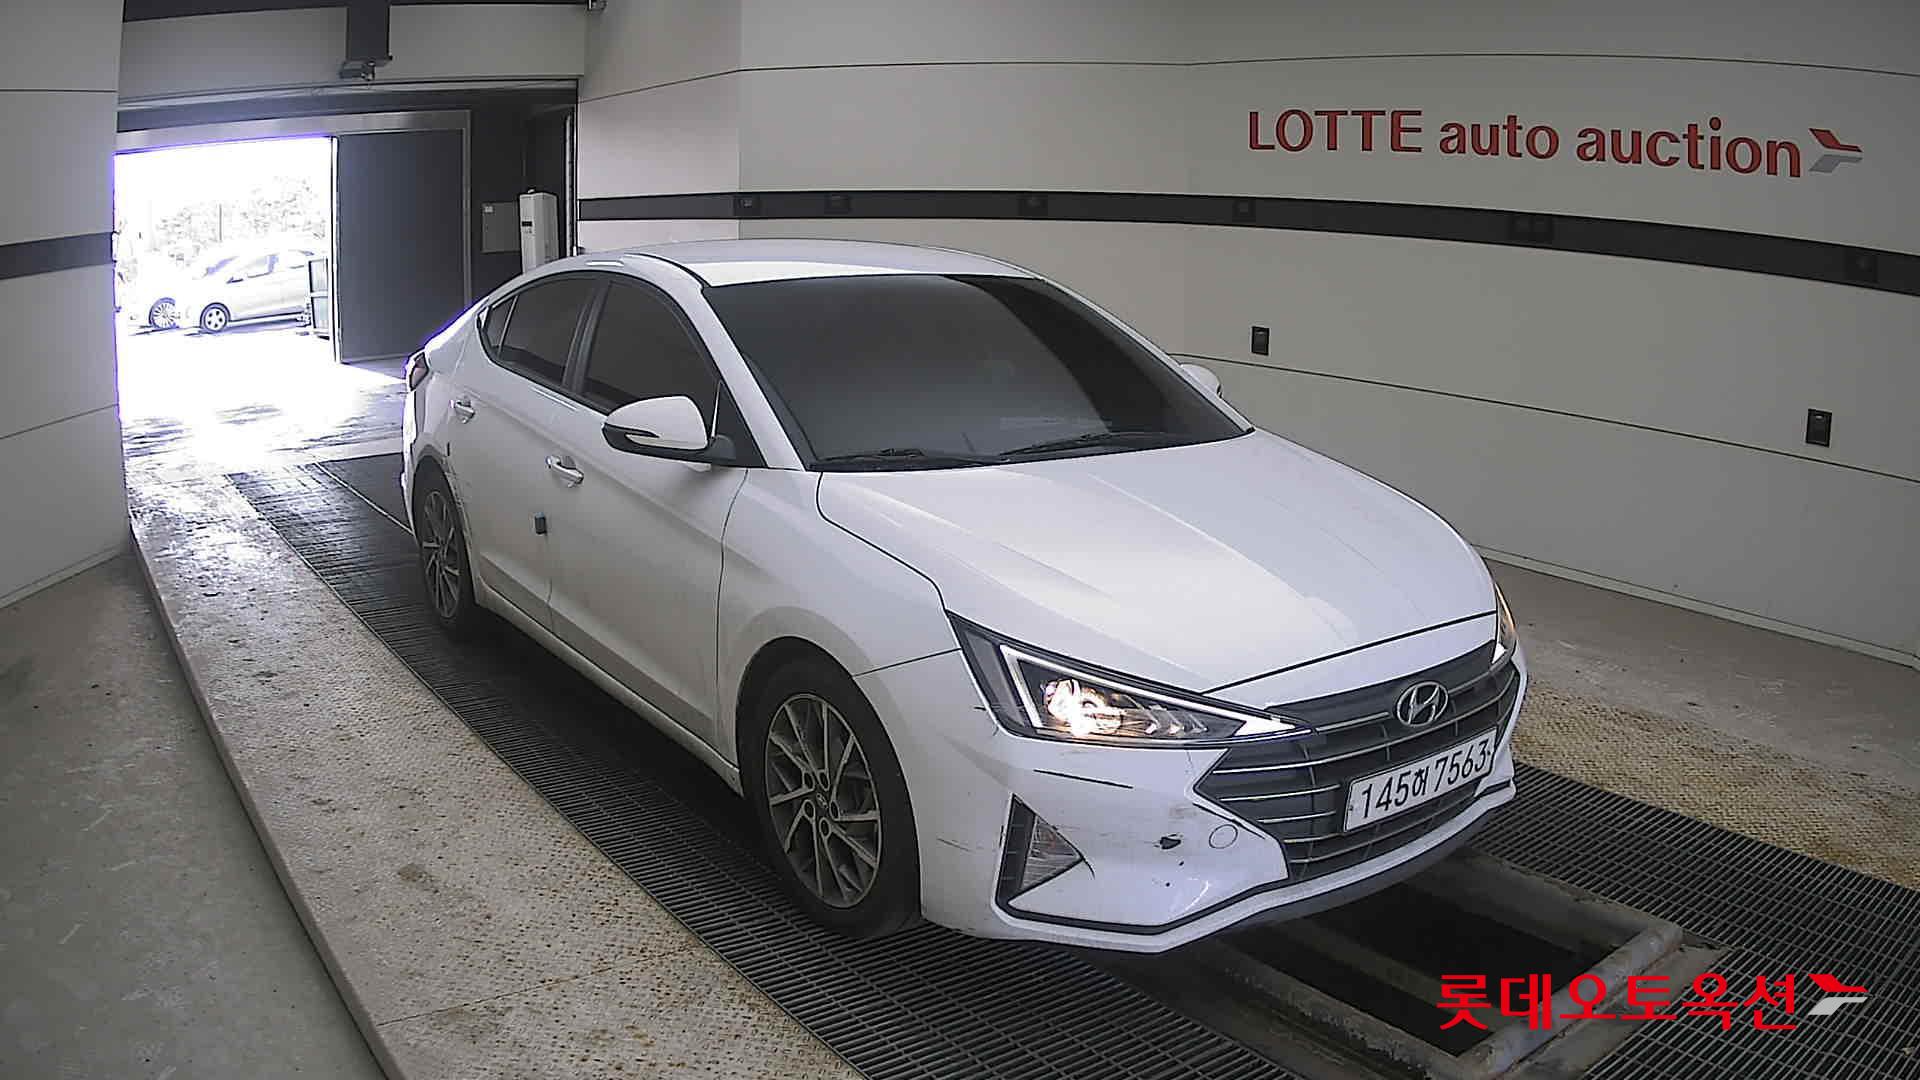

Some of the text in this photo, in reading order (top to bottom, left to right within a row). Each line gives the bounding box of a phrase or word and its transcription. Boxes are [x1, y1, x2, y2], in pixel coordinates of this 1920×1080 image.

[1248, 109, 1801, 178] LOTTE auto auction
